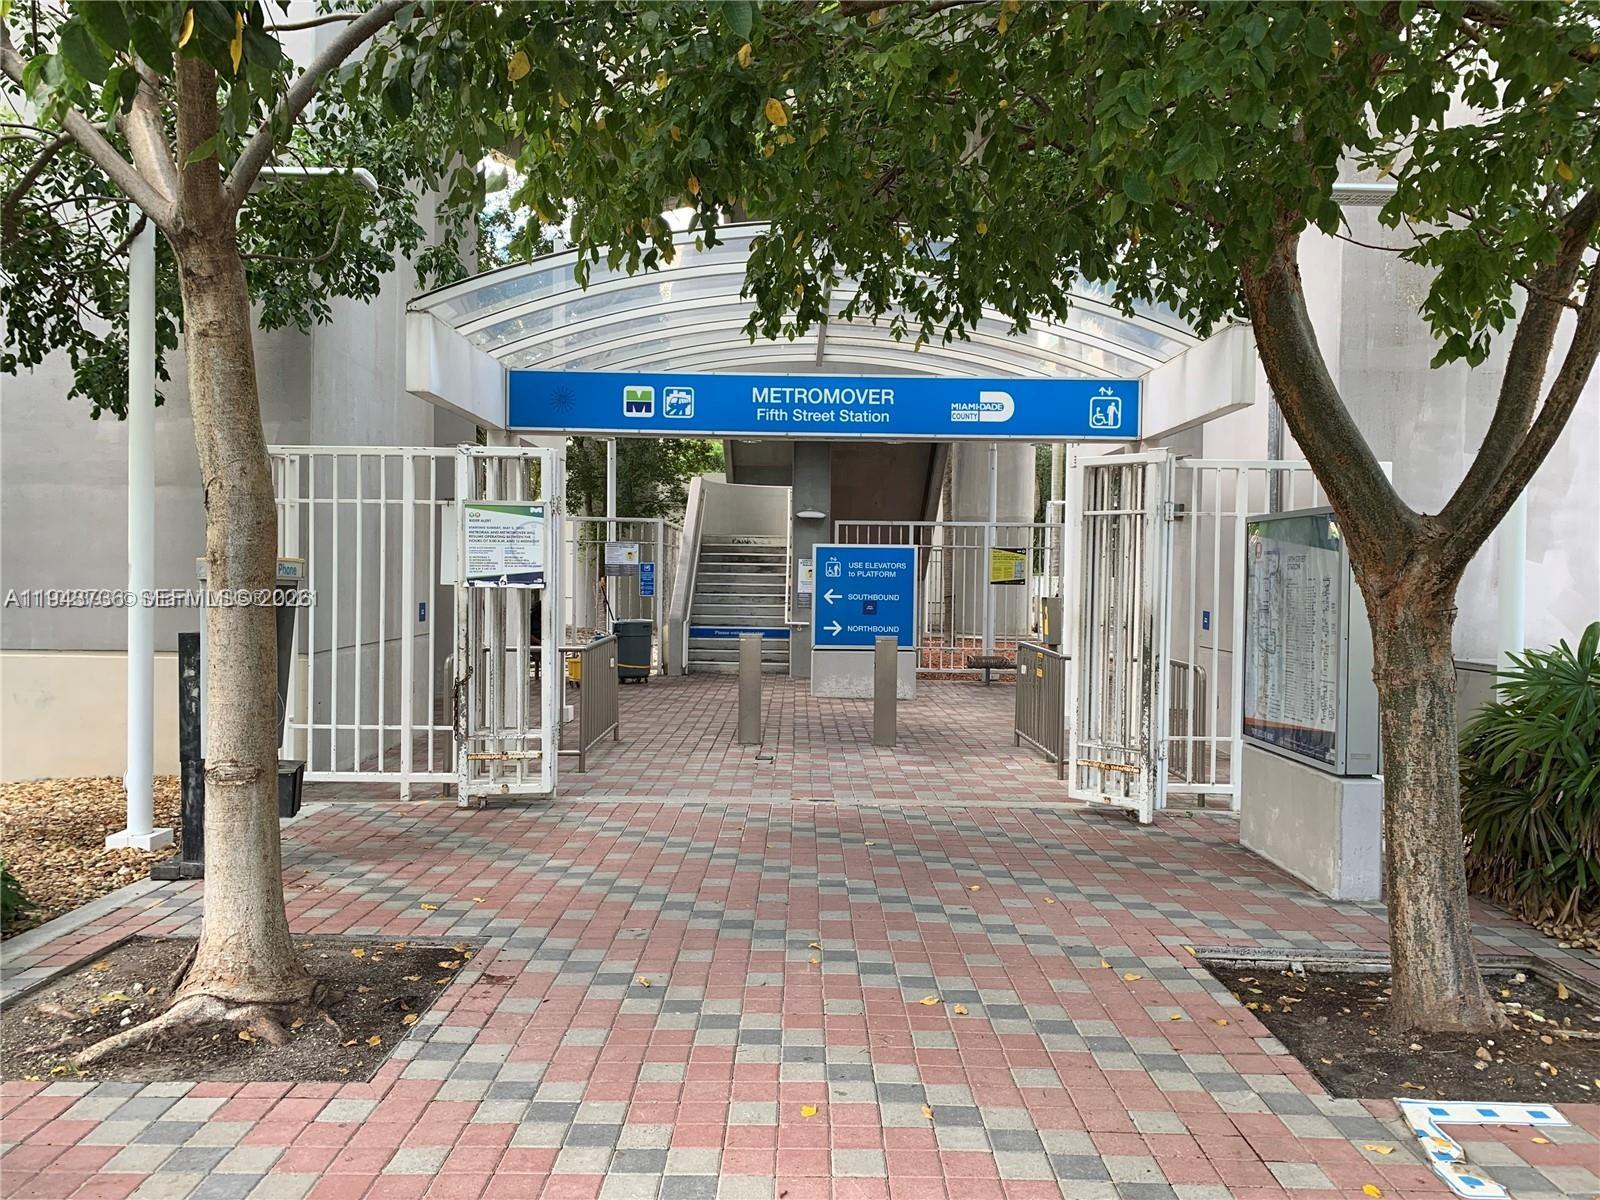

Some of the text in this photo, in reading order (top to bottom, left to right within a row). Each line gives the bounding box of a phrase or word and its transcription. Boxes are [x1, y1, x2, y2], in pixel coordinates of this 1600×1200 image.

[752, 387, 895, 405] METROMOVER
[951, 402, 1004, 411] MIAMI-DADE
[757, 408, 890, 422] Fifth Street Station
[952, 412, 978, 420] COUNTY
[278, 562, 297, 576] Phone
[848, 562, 907, 570] USE ELEVATORS
[847, 625, 900, 633] NORTHBOUND
